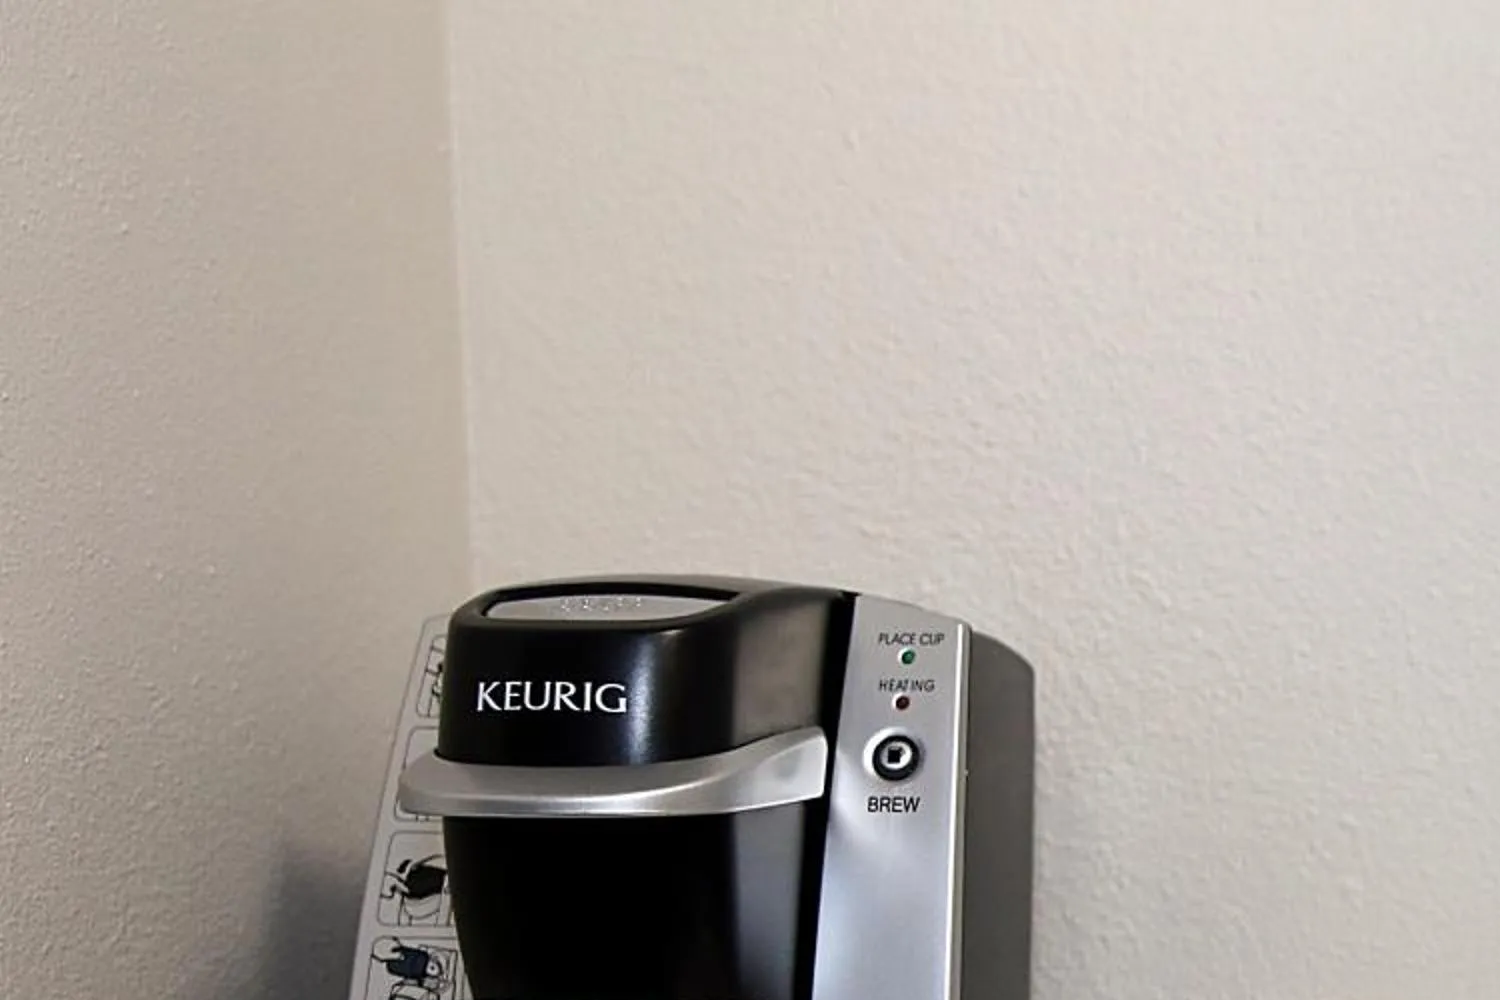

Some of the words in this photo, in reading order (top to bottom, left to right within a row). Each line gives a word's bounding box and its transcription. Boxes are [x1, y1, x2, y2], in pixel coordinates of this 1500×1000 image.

[878, 632, 917, 645] PLACE
[919, 633, 945, 645] CUP
[878, 679, 936, 692] HEATING
[476, 680, 628, 713] KEURIG
[867, 796, 921, 813] BREW
